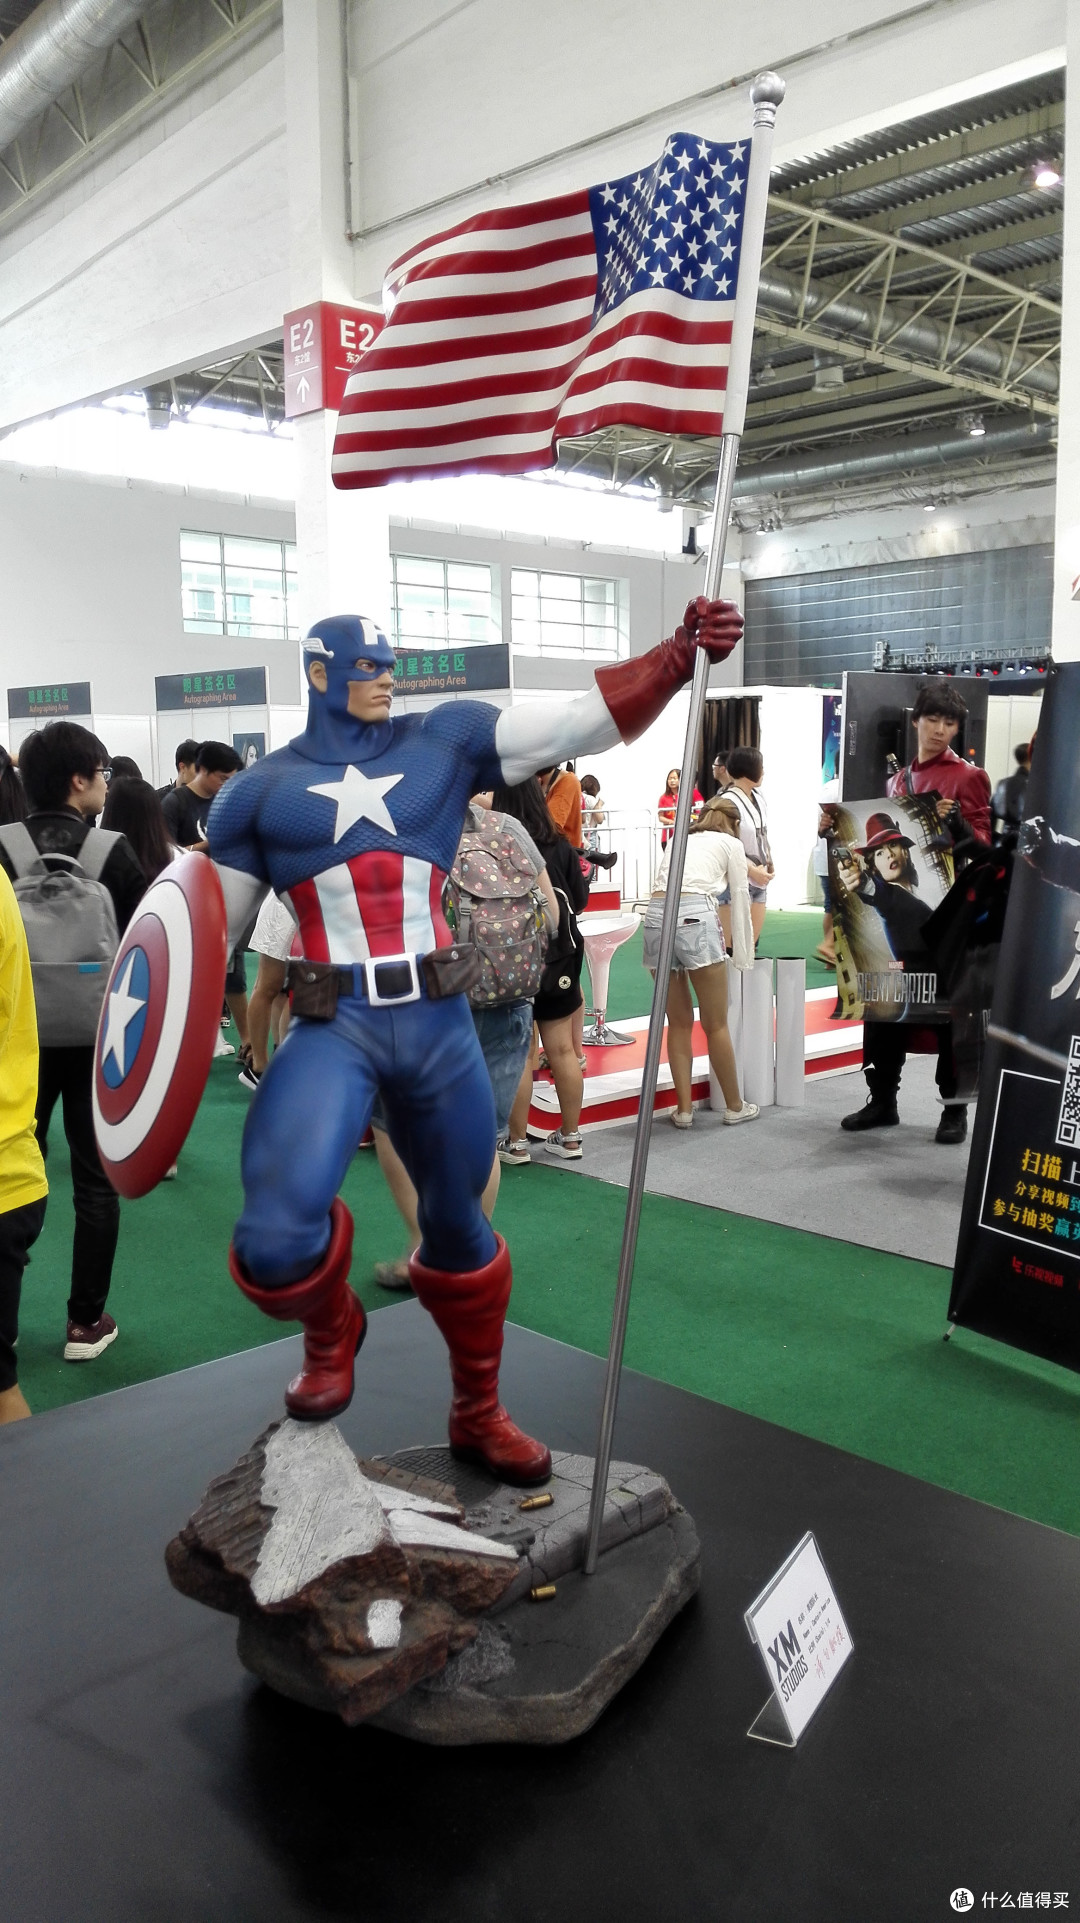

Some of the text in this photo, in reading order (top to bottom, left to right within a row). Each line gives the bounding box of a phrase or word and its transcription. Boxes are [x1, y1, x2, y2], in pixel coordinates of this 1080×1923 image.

[290, 318, 314, 353] E2
[340, 318, 374, 351] E2
[345, 351, 363, 364] 东2
[183, 674, 236, 693] 明星签名区
[393, 675, 467, 691] Autographing Area
[184, 692, 237, 705] Autographing Area
[29, 703, 69, 714] Autographing Area
[888, 961, 904, 970] MARVEL
[857, 972, 937, 1004] AGENT CARTER
[767, 1619, 802, 1684] XM
[780, 1655, 809, 1703] STUDIOS
